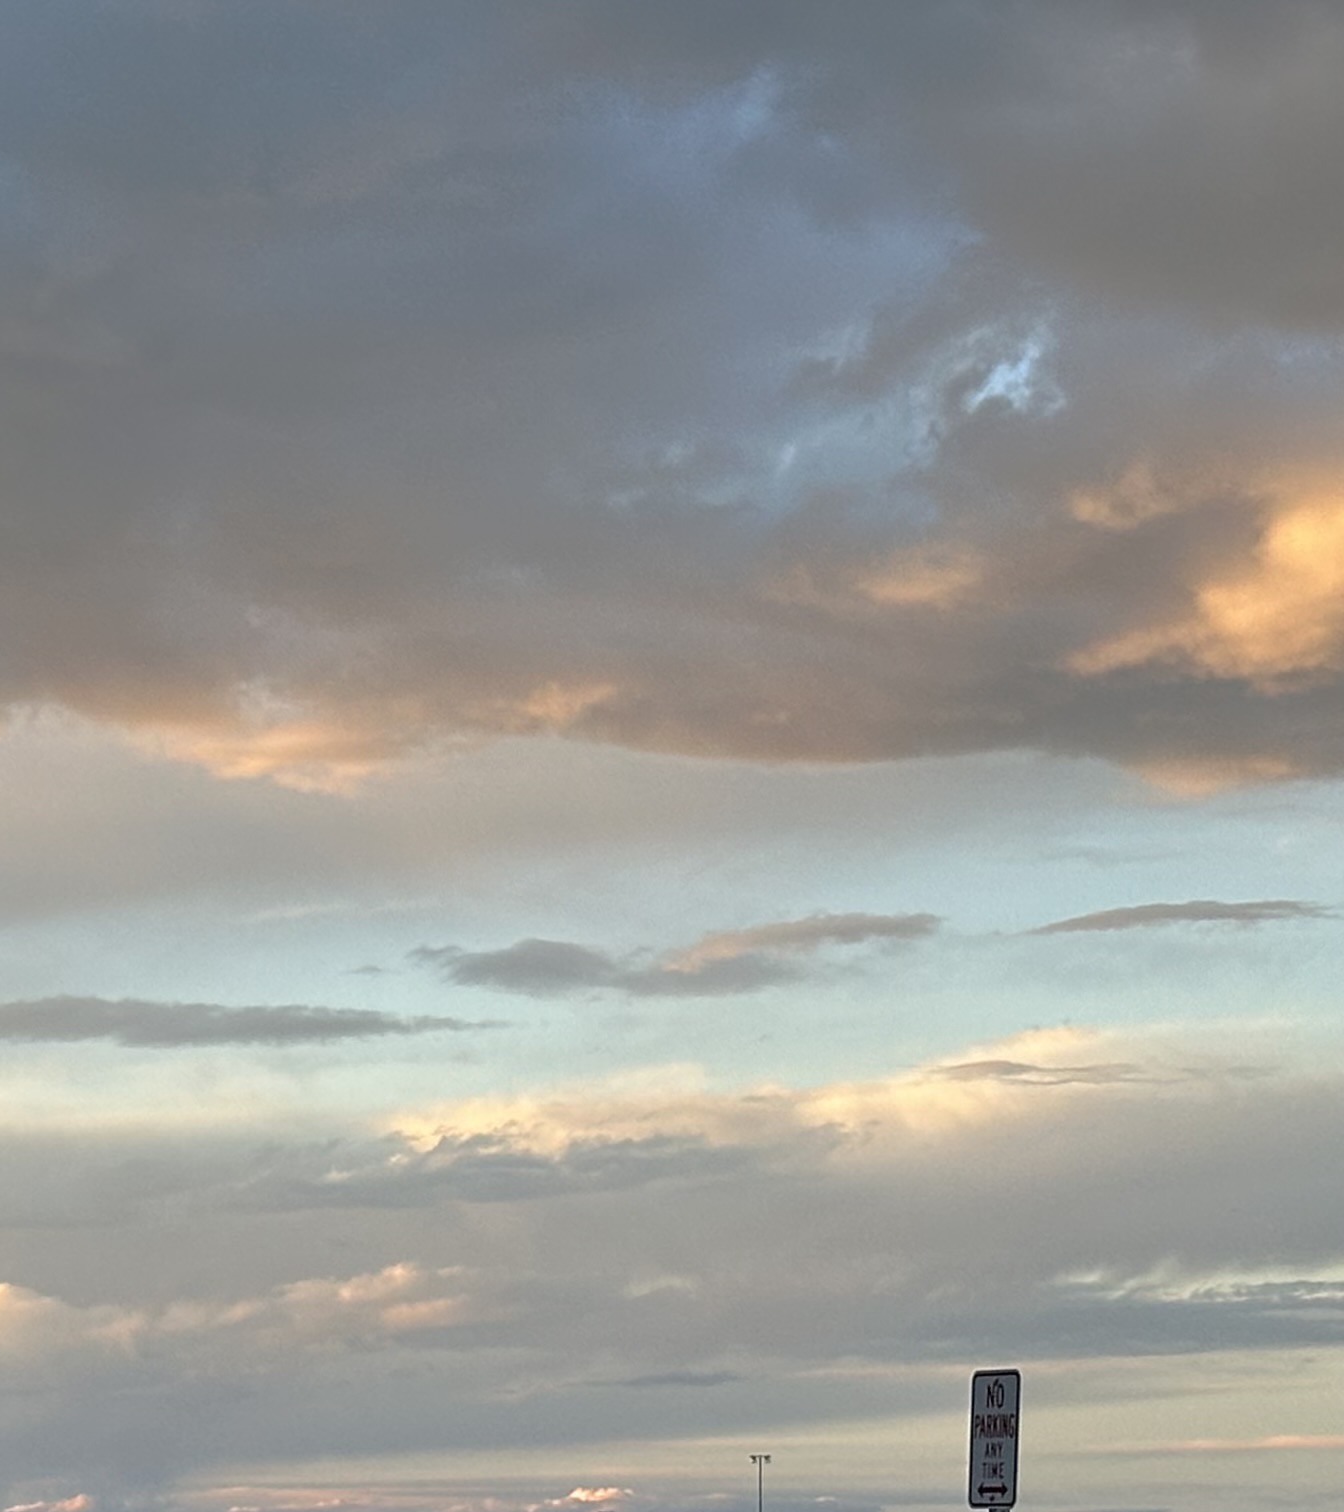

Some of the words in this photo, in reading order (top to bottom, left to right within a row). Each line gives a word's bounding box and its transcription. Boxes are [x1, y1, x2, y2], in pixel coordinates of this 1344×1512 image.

[986, 1383, 1005, 1409] NO
[974, 1414, 1015, 1439] PARKING
[984, 1442, 1003, 1459] ANY
[981, 1462, 1005, 1480] TIME
